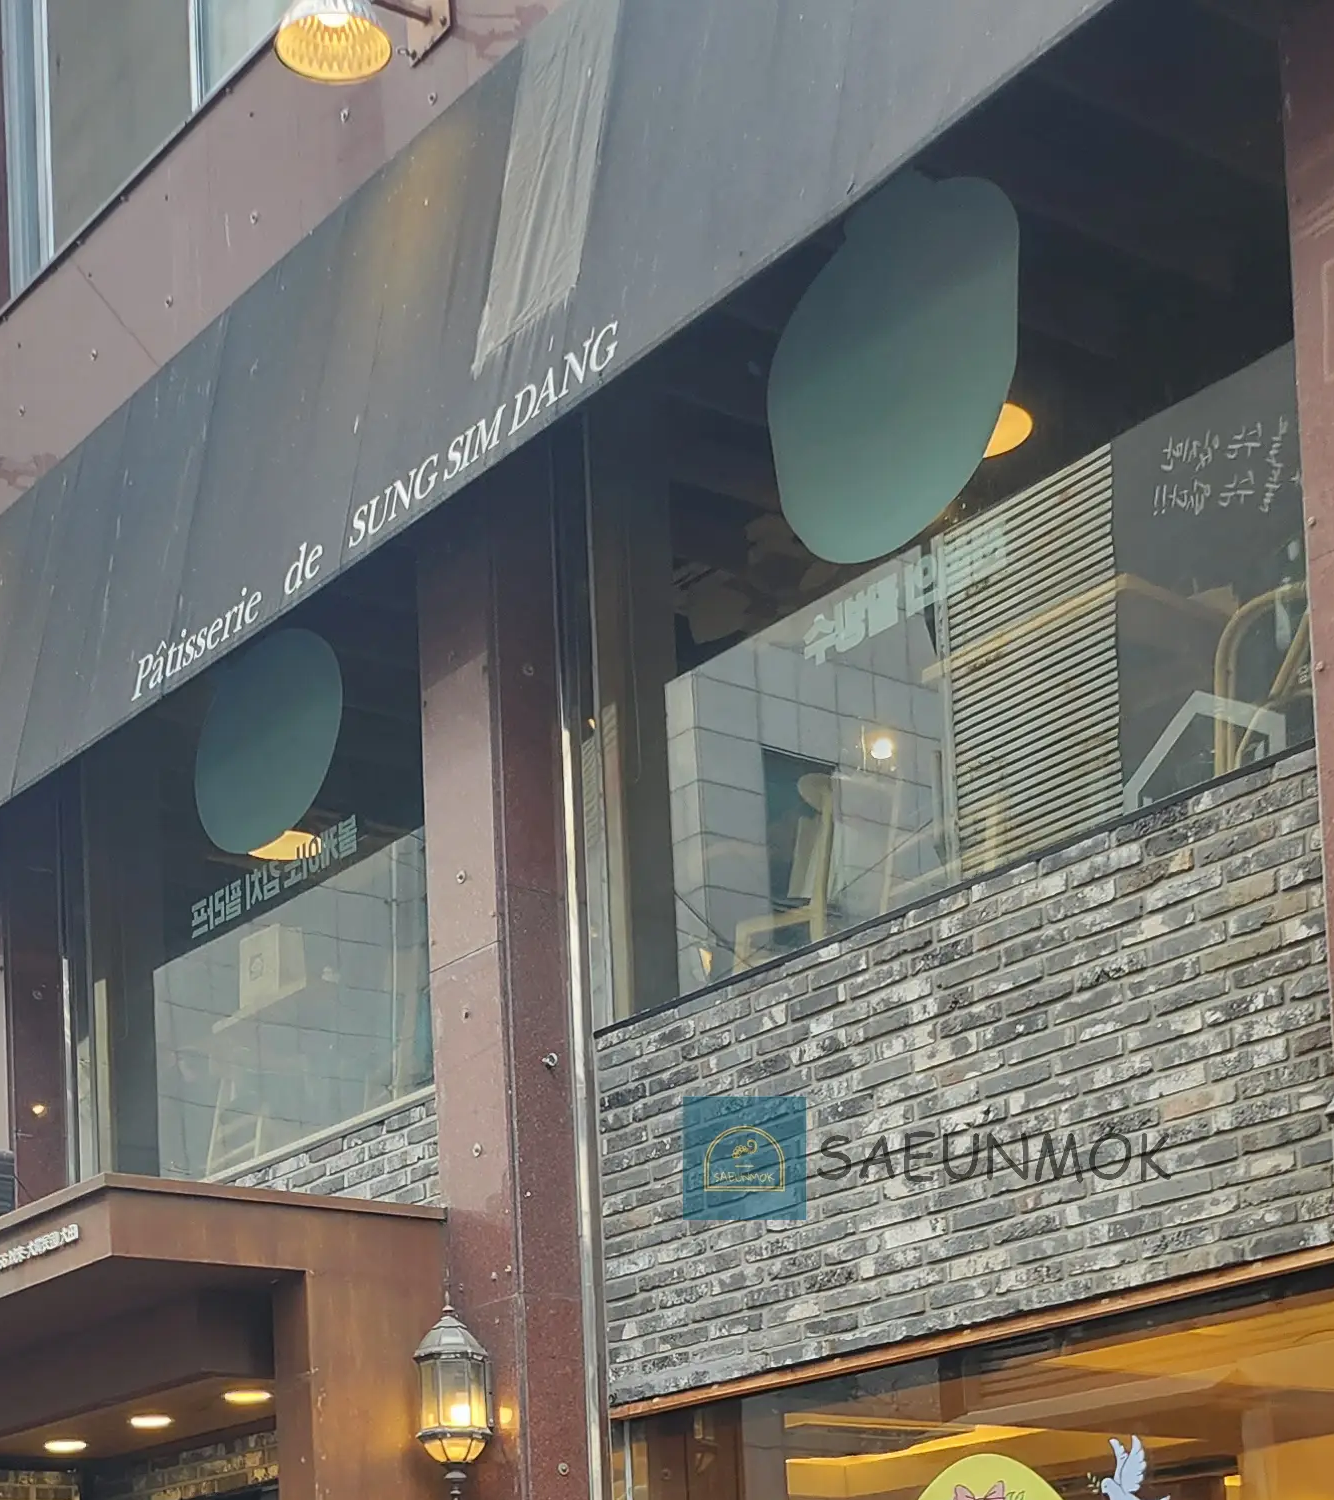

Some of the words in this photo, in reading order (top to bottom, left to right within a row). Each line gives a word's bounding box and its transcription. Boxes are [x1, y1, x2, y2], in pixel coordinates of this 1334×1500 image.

[131, 586, 262, 701] Pâtisserie
[284, 542, 323, 595] de
[348, 454, 440, 549] SUNG
[443, 404, 507, 482] SIM
[507, 321, 618, 437] DANG
